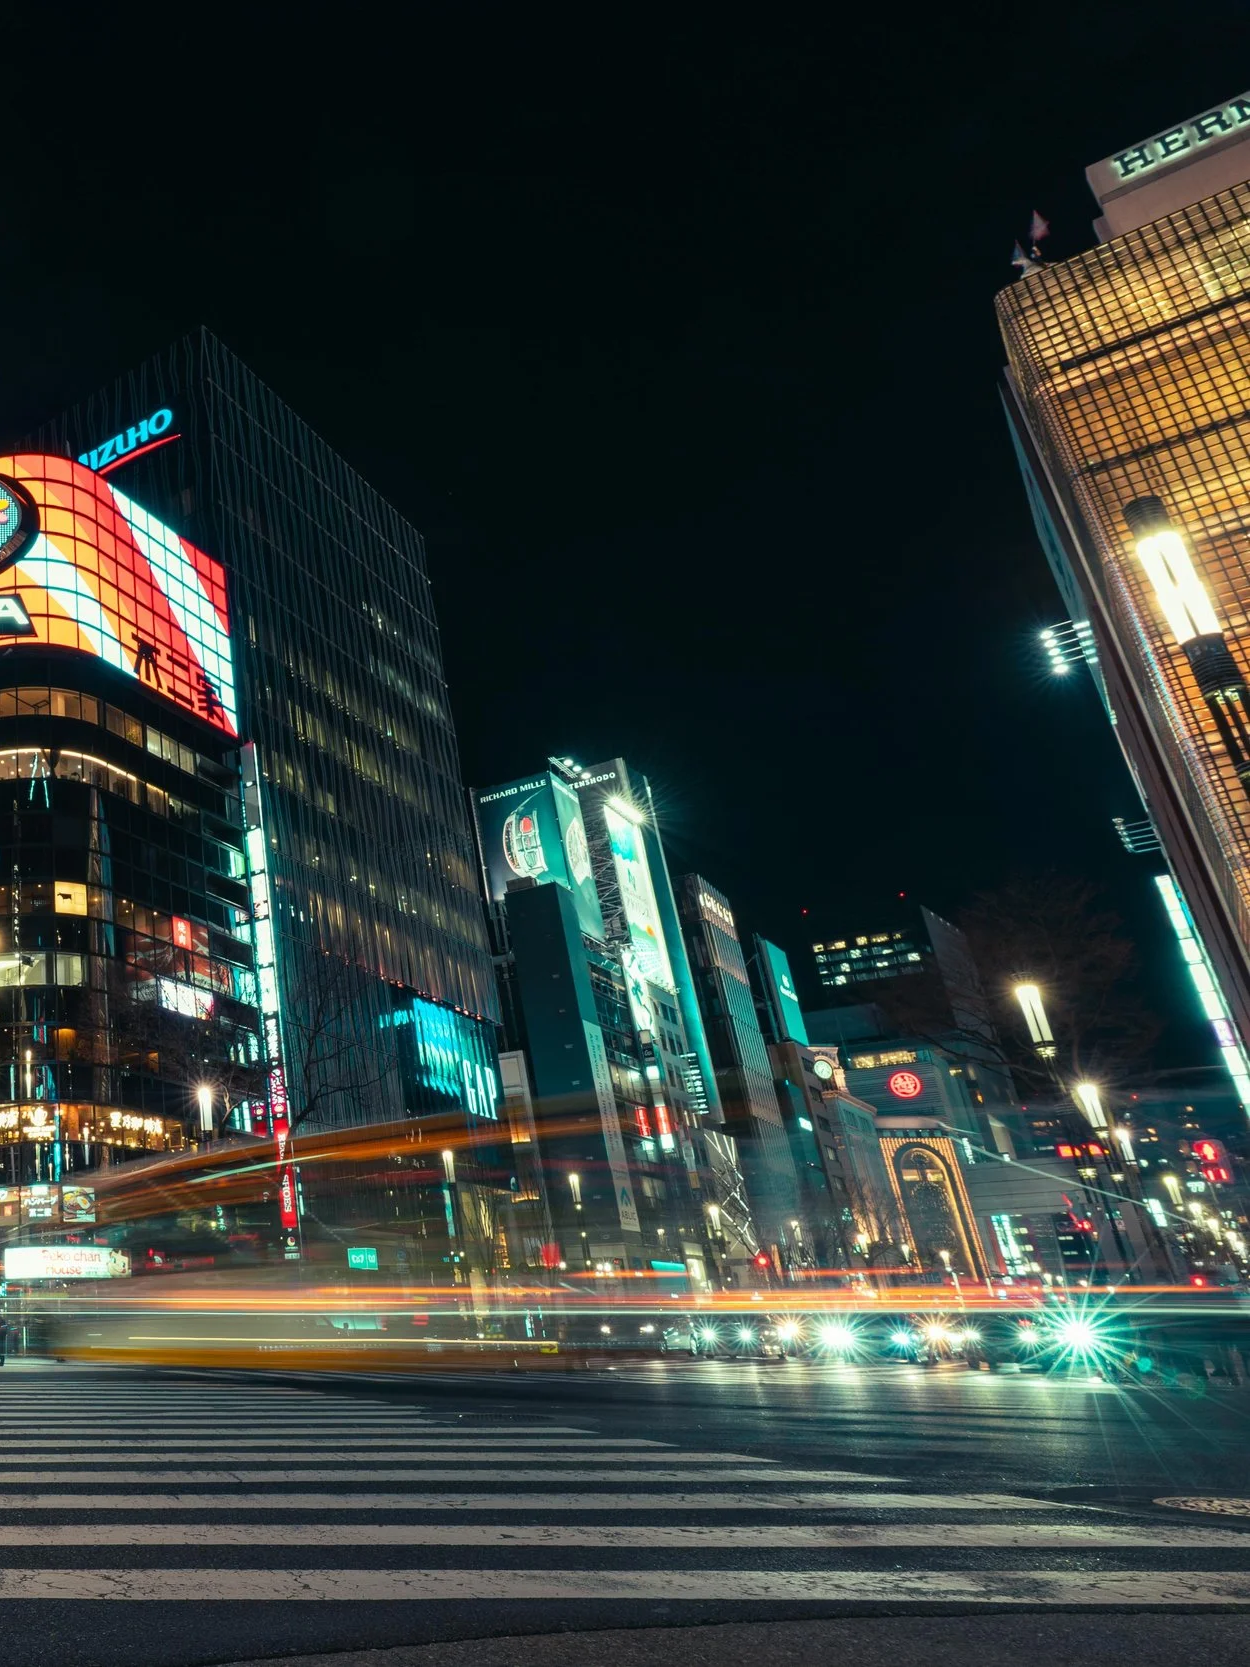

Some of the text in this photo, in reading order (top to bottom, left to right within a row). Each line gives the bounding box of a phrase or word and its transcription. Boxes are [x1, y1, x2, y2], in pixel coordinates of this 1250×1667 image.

[480, 788, 518, 804] RICHARD
[520, 779, 547, 793] MILLE
[569, 772, 616, 790] TENSHODO
[177, 921, 187, 945] 焼肉
[463, 1059, 498, 1120] GAP
[73, 1249, 101, 1262] chan
